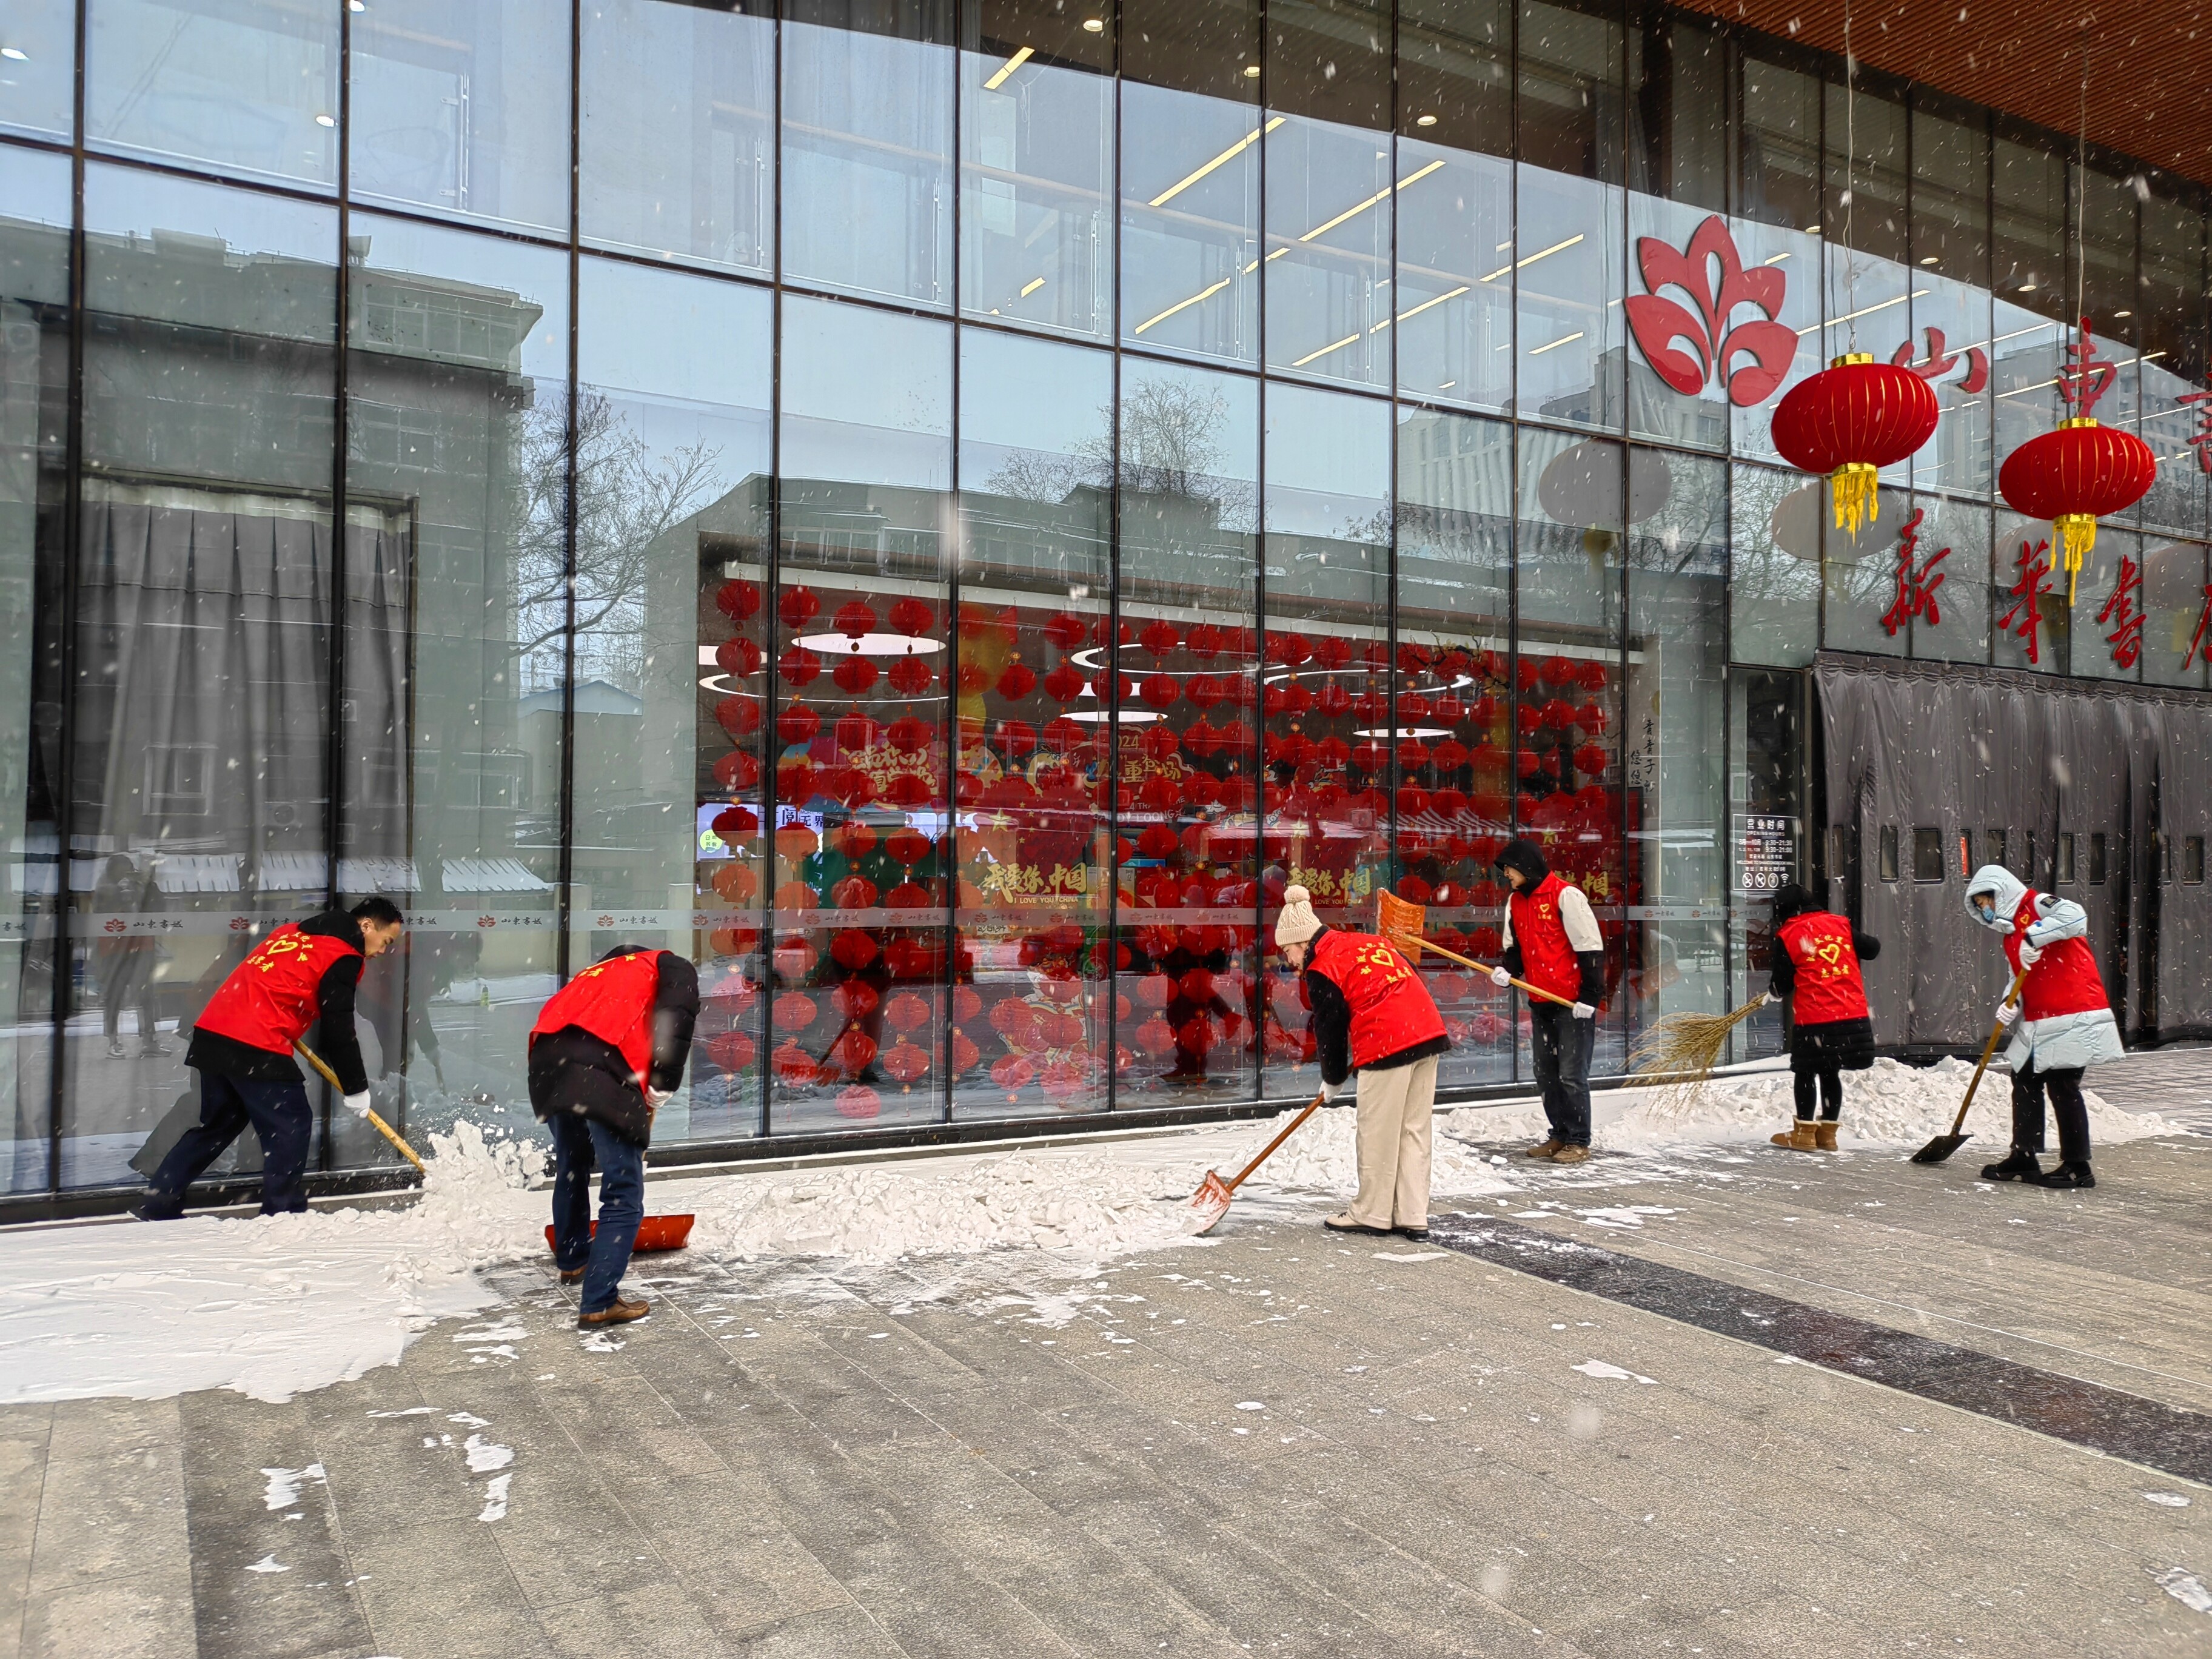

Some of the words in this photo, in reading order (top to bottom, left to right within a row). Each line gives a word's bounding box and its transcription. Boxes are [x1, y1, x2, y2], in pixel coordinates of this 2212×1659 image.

[1746, 819, 1785, 830] 营业时间
[1821, 964, 1849, 978] 志愿者
